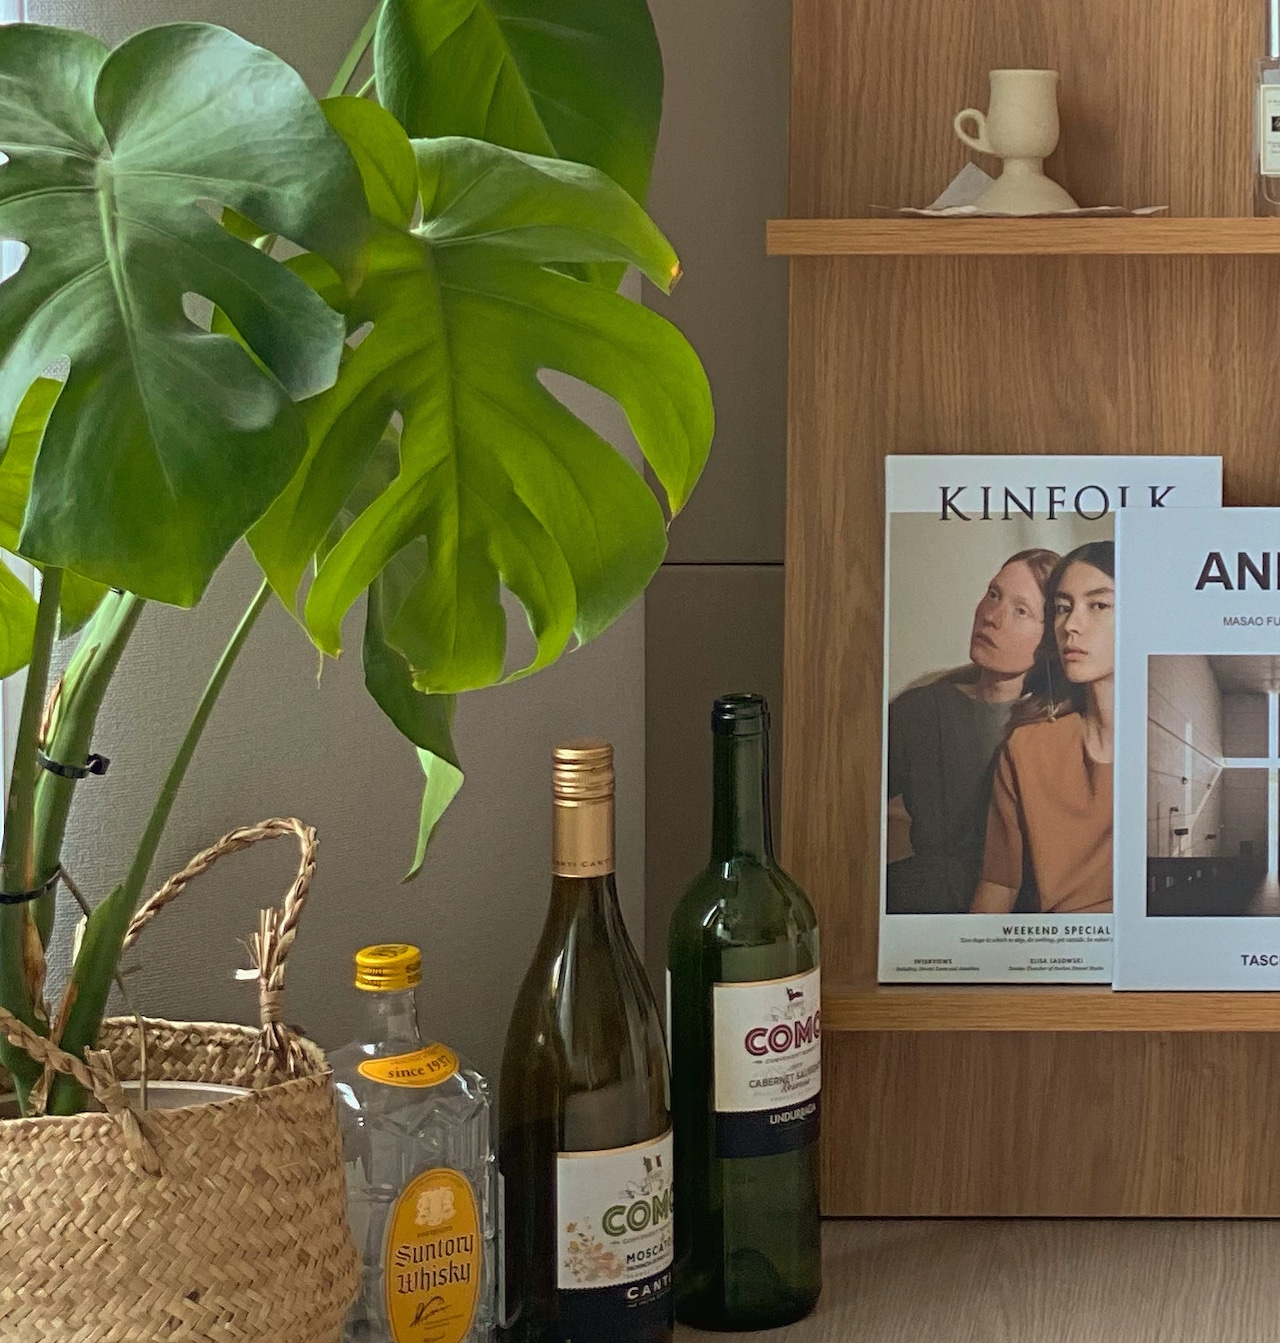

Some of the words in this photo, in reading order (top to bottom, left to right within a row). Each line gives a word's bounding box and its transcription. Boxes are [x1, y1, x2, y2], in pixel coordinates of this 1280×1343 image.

[1223, 616, 1264, 627] MASAO
[1002, 926, 1059, 935] WEEKEND
[1064, 926, 1111, 935] SPECIAL
[388, 1066, 425, 1078] since
[394, 1234, 473, 1267] Suntory
[397, 1260, 471, 1294] Whisky
[626, 1271, 672, 1300] CANTI
